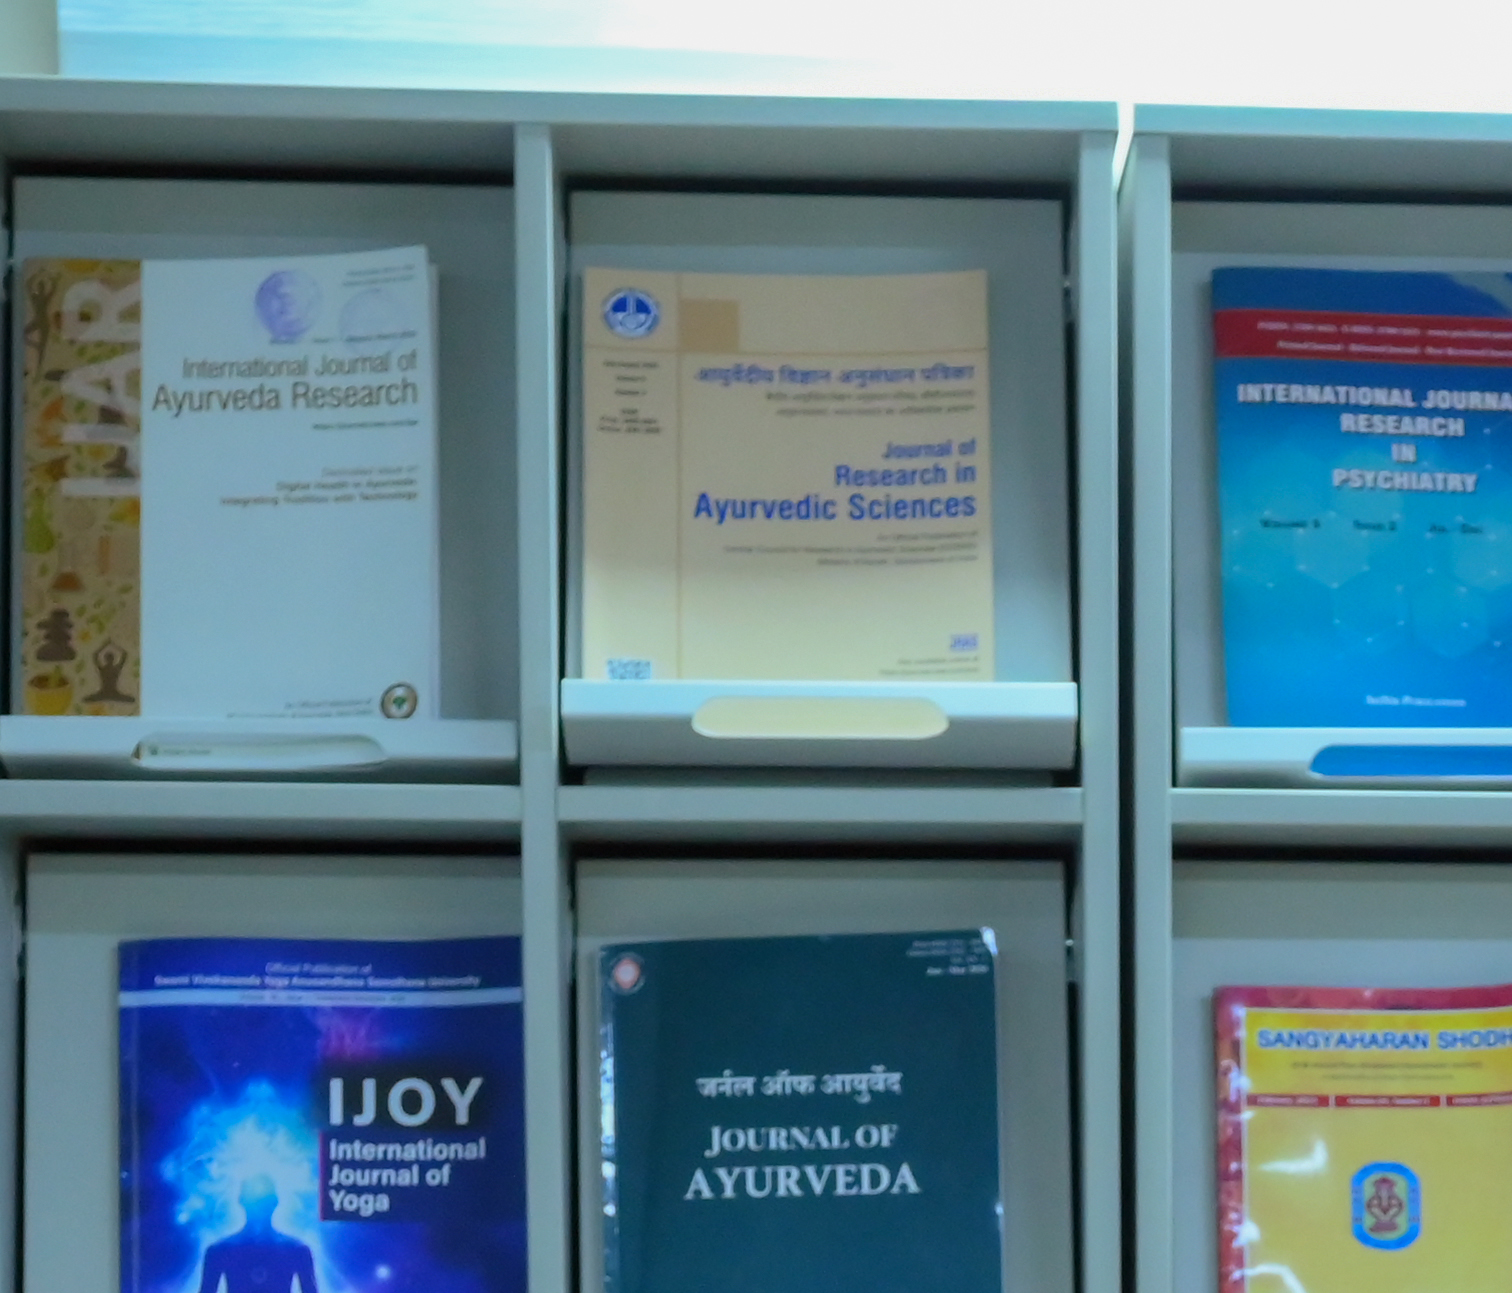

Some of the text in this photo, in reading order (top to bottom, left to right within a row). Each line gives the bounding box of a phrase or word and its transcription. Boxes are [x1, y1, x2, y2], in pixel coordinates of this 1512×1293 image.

[182, 349, 418, 380] International Journal of
[152, 378, 419, 418] Ayurveda Research
[1237, 383, 1416, 409] INTERNATIONAL
[1340, 413, 1465, 437] RESEARCH
[883, 437, 976, 460] Journal of
[1391, 443, 1416, 462] IN
[835, 462, 976, 488] Research in
[1332, 468, 1478, 493] PSYCHIATRY
[694, 492, 976, 525] Ayurvedic Sciences
[1258, 1029, 1429, 1050] SANGYAHARAN
[696, 1069, 756, 1098] जर्नल
[821, 1065, 903, 1104] आयुर्वेद
[329, 1076, 484, 1127] IJOY
[329, 1137, 486, 1161] International
[705, 1123, 899, 1158] JOURNAL OF
[329, 1164, 451, 1188] Journal of
[684, 1161, 922, 1201] AYURVEDA
[329, 1190, 390, 1217] Yoga
